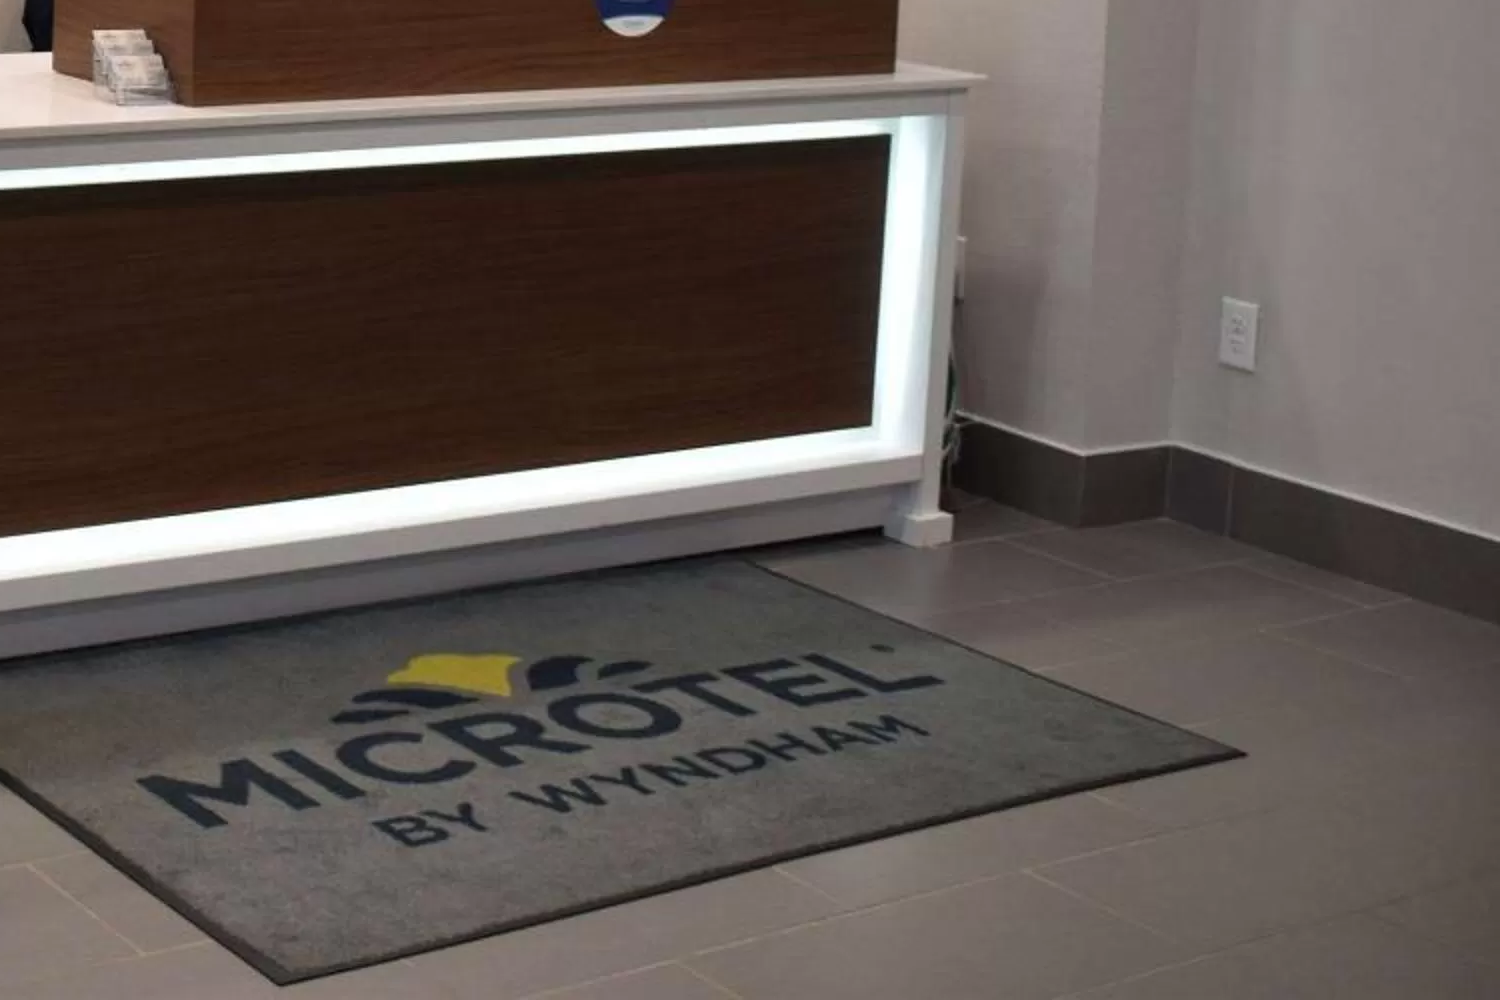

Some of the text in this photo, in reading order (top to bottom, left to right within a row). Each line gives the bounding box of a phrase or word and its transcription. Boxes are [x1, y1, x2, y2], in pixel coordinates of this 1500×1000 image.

[136, 652, 945, 829] MICROTEL
[372, 713, 931, 848] BY WYNDHAM
